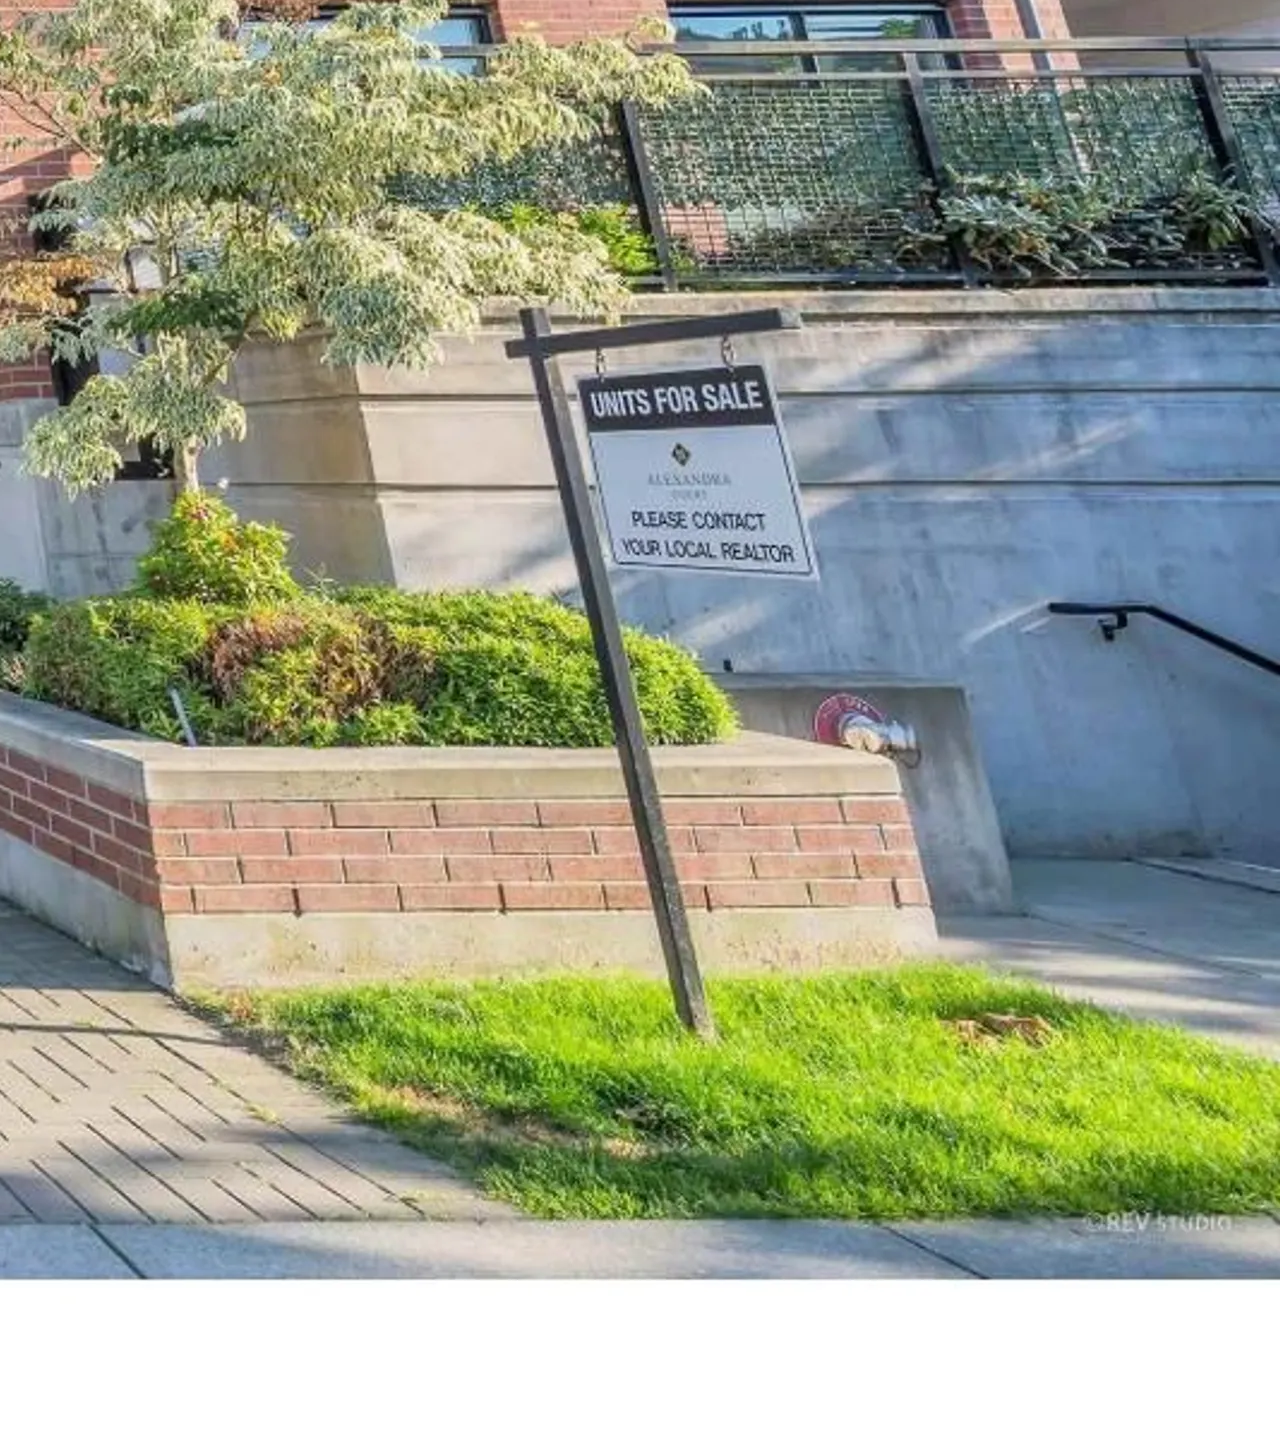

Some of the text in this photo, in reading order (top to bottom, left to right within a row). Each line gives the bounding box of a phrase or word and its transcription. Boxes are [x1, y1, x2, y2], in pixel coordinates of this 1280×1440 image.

[590, 380, 764, 418] UNITS FOR SALE
[631, 511, 766, 532] PLEASE CONTACT
[622, 539, 794, 563] YOUR LOCAL REALTOR
